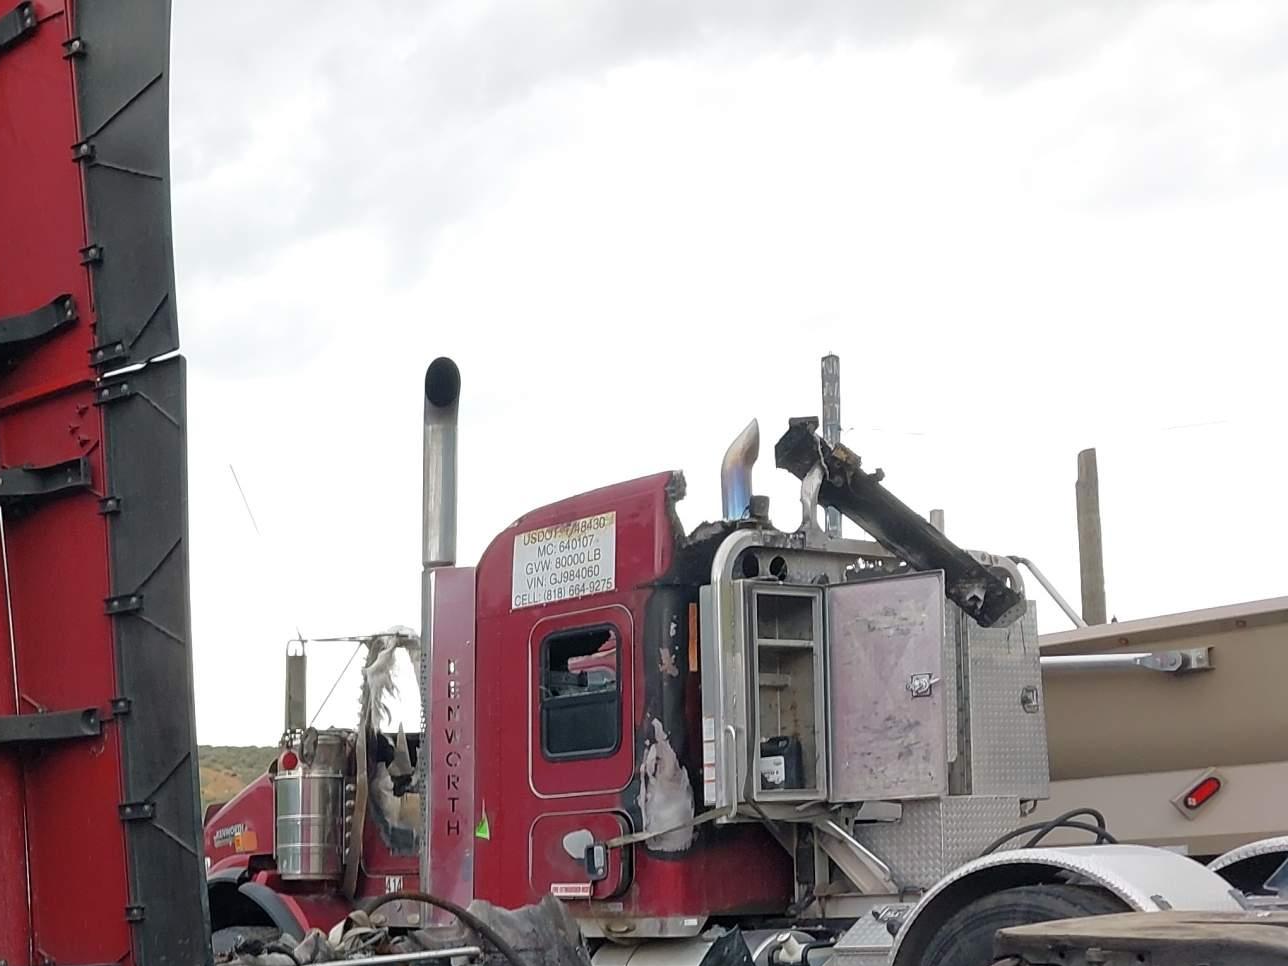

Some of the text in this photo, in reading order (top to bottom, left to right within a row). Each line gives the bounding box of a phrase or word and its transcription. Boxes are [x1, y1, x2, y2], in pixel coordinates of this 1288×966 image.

[537, 535, 594, 558] MC: 640107
[526, 548, 601, 575] GVW: 80000 LB
[527, 564, 600, 590] VIN: GJ984060
[514, 577, 612, 607] CELL: (818) 664-9275
